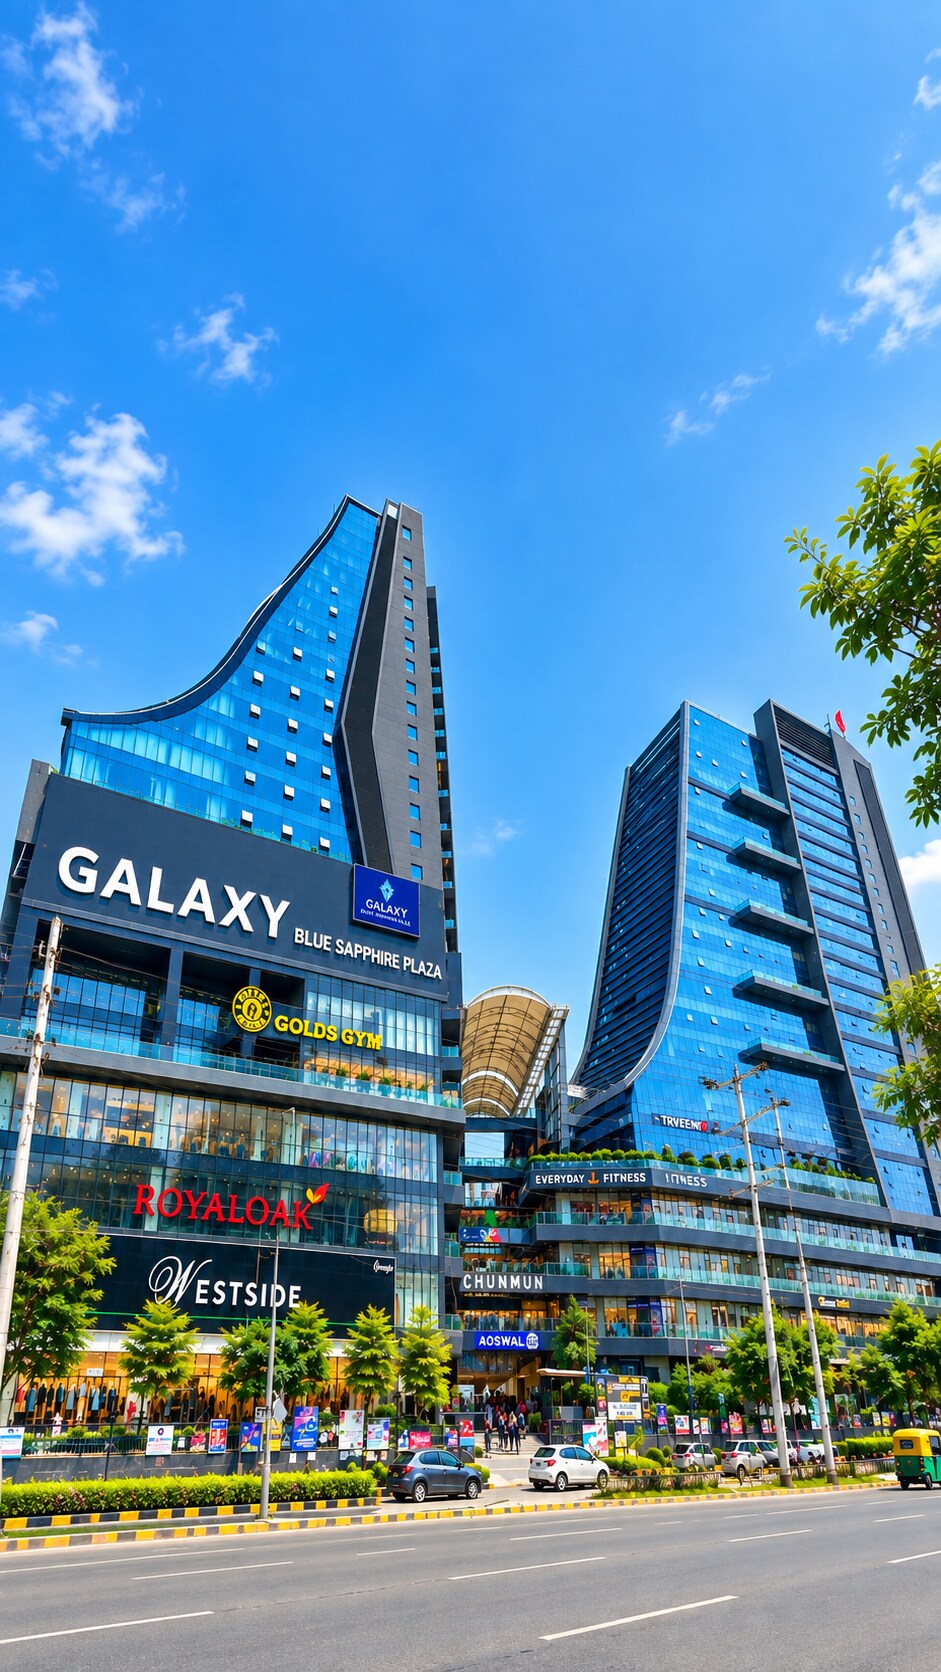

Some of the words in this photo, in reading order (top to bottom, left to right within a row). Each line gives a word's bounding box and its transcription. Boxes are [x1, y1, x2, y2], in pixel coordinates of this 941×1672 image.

[58, 846, 291, 939] GALAXY
[365, 898, 408, 919] GALAXY
[294, 927, 332, 953] BLUE
[335, 939, 400, 969] SAPPHIRE
[402, 955, 443, 981] PLAZA
[274, 1014, 338, 1042] GOLDS
[341, 1028, 382, 1051] GYM
[535, 1174, 585, 1185] EVERYDAY
[603, 1172, 647, 1183] FITNESS
[133, 1184, 313, 1230] ROYALOAK
[149, 1255, 301, 1309] WESTSIDE
[463, 1273, 543, 1290] CHUNMUN
[478, 1335, 525, 1347] AOSWAL
